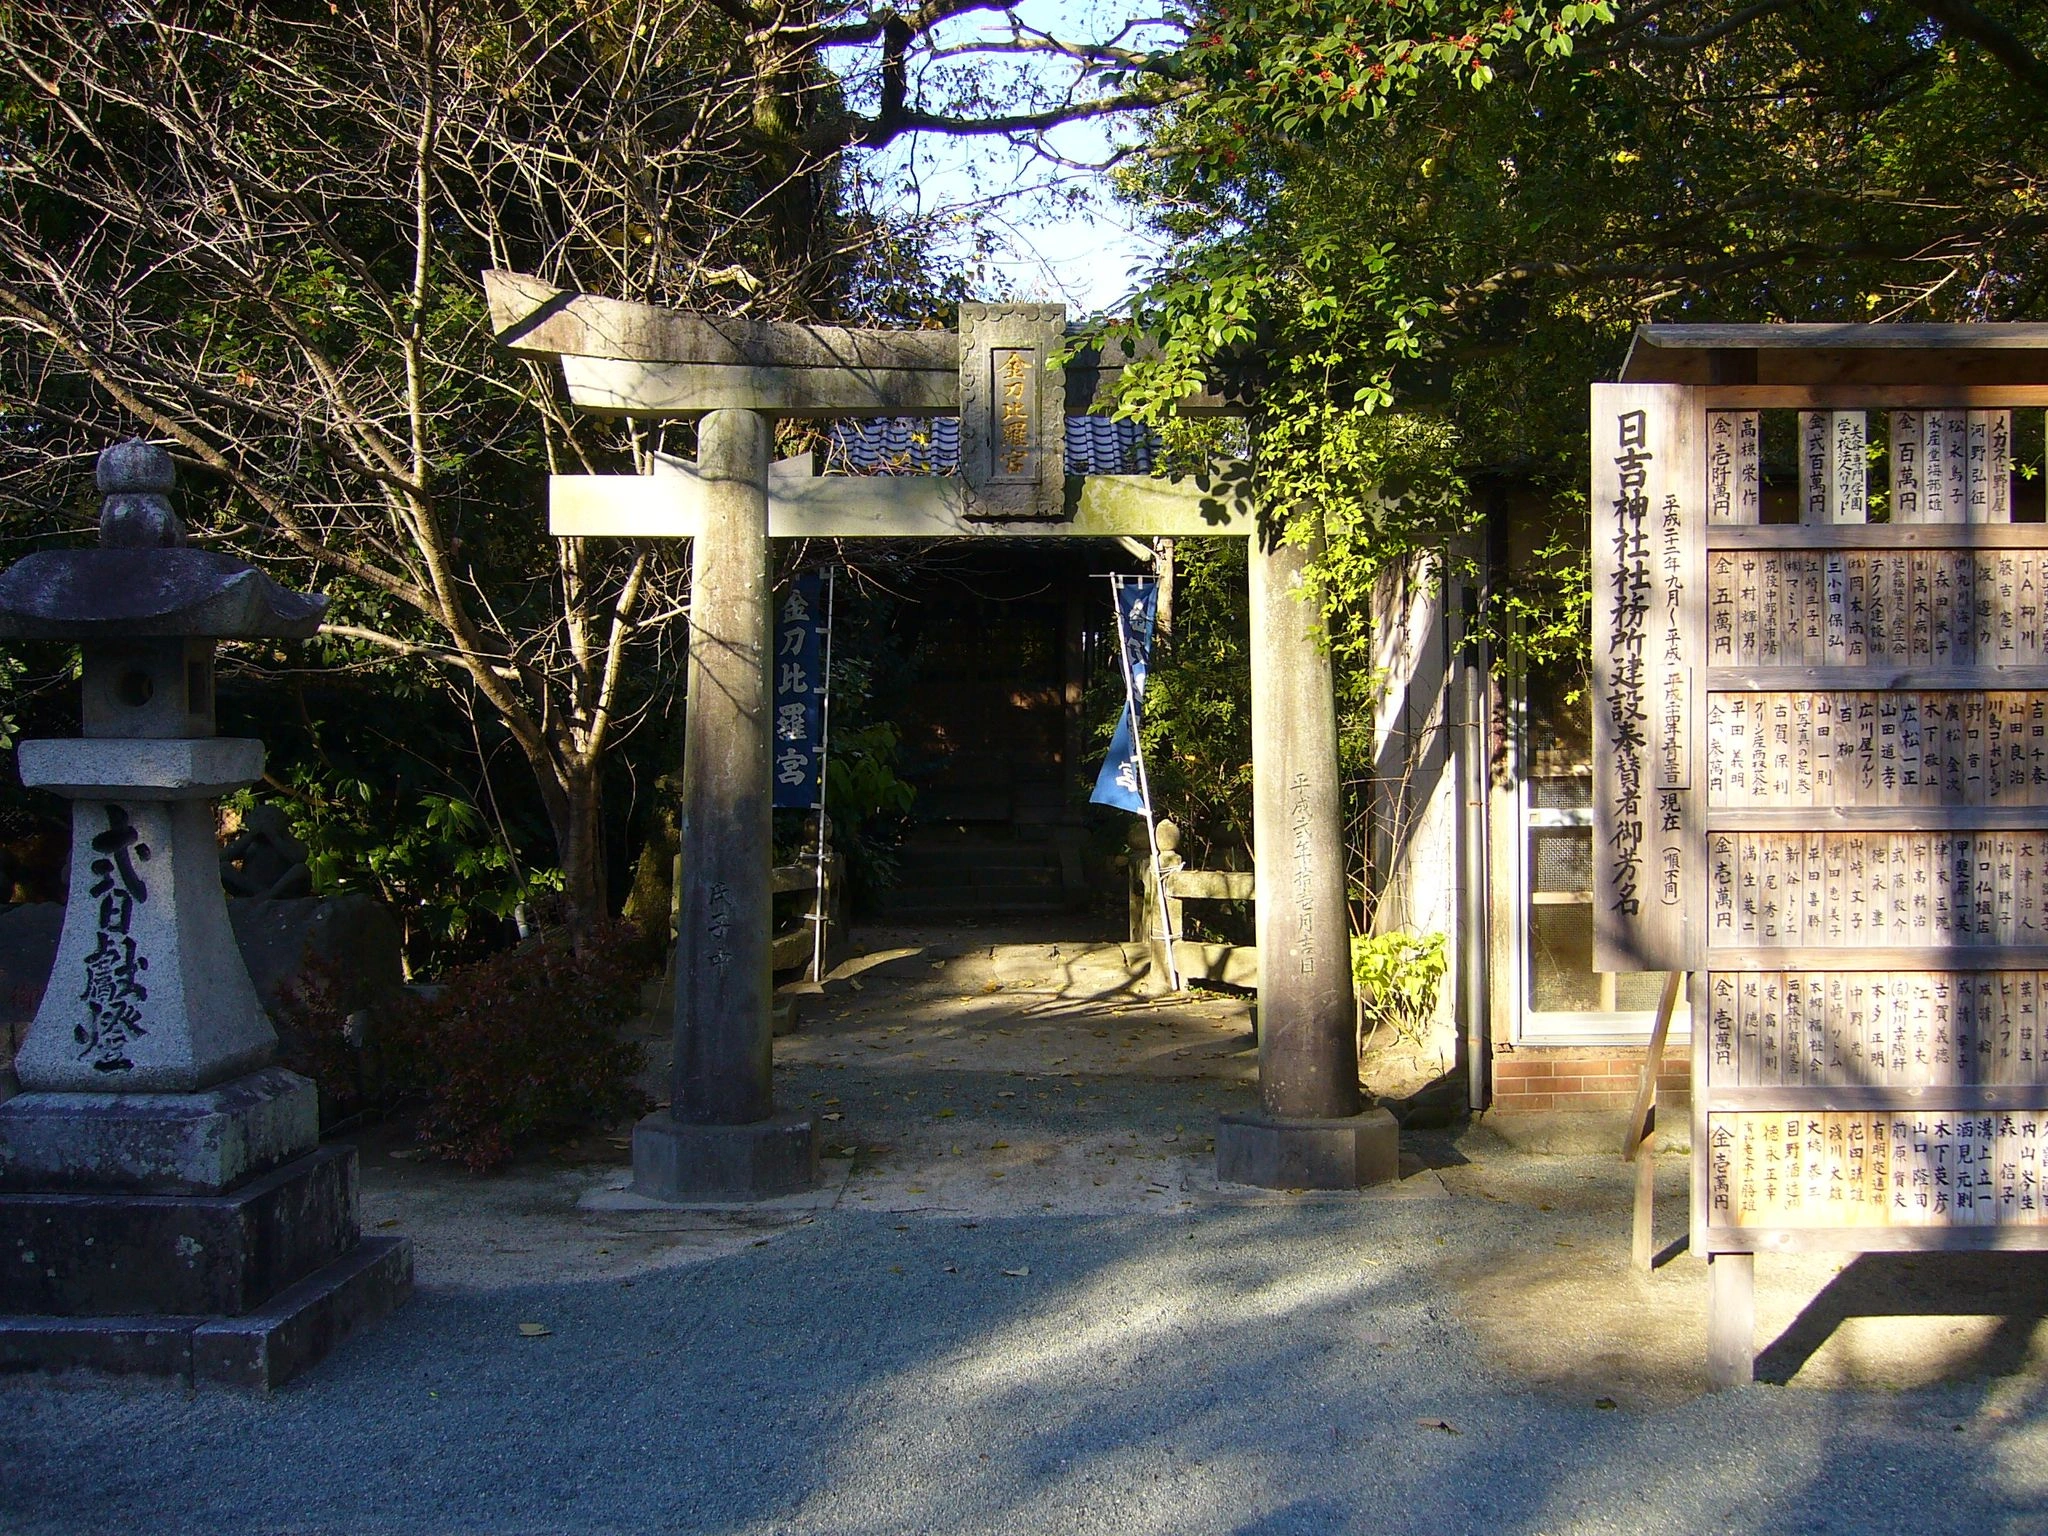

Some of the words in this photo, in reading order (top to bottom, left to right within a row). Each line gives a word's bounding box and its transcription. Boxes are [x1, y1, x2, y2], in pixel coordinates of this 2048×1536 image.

[997, 351, 1033, 474] 金刀比羅宮
[1828, 563, 1843, 647] 三小田保弘
[776, 589, 810, 786] 金刀比羅宮
[1607, 409, 1653, 917] 日吉神社社務所建設奉賛者御芳名
[1817, 703, 1832, 786] 山田一則
[1881, 704, 1896, 789] 山田道孝
[1902, 704, 1919, 785] 広松一正
[2010, 703, 2025, 784] 山田良治
[2031, 700, 2048, 784] 吉田千春
[1660, 794, 1681, 832] 現在
[1976, 840, 1992, 934] 川口仏壇店
